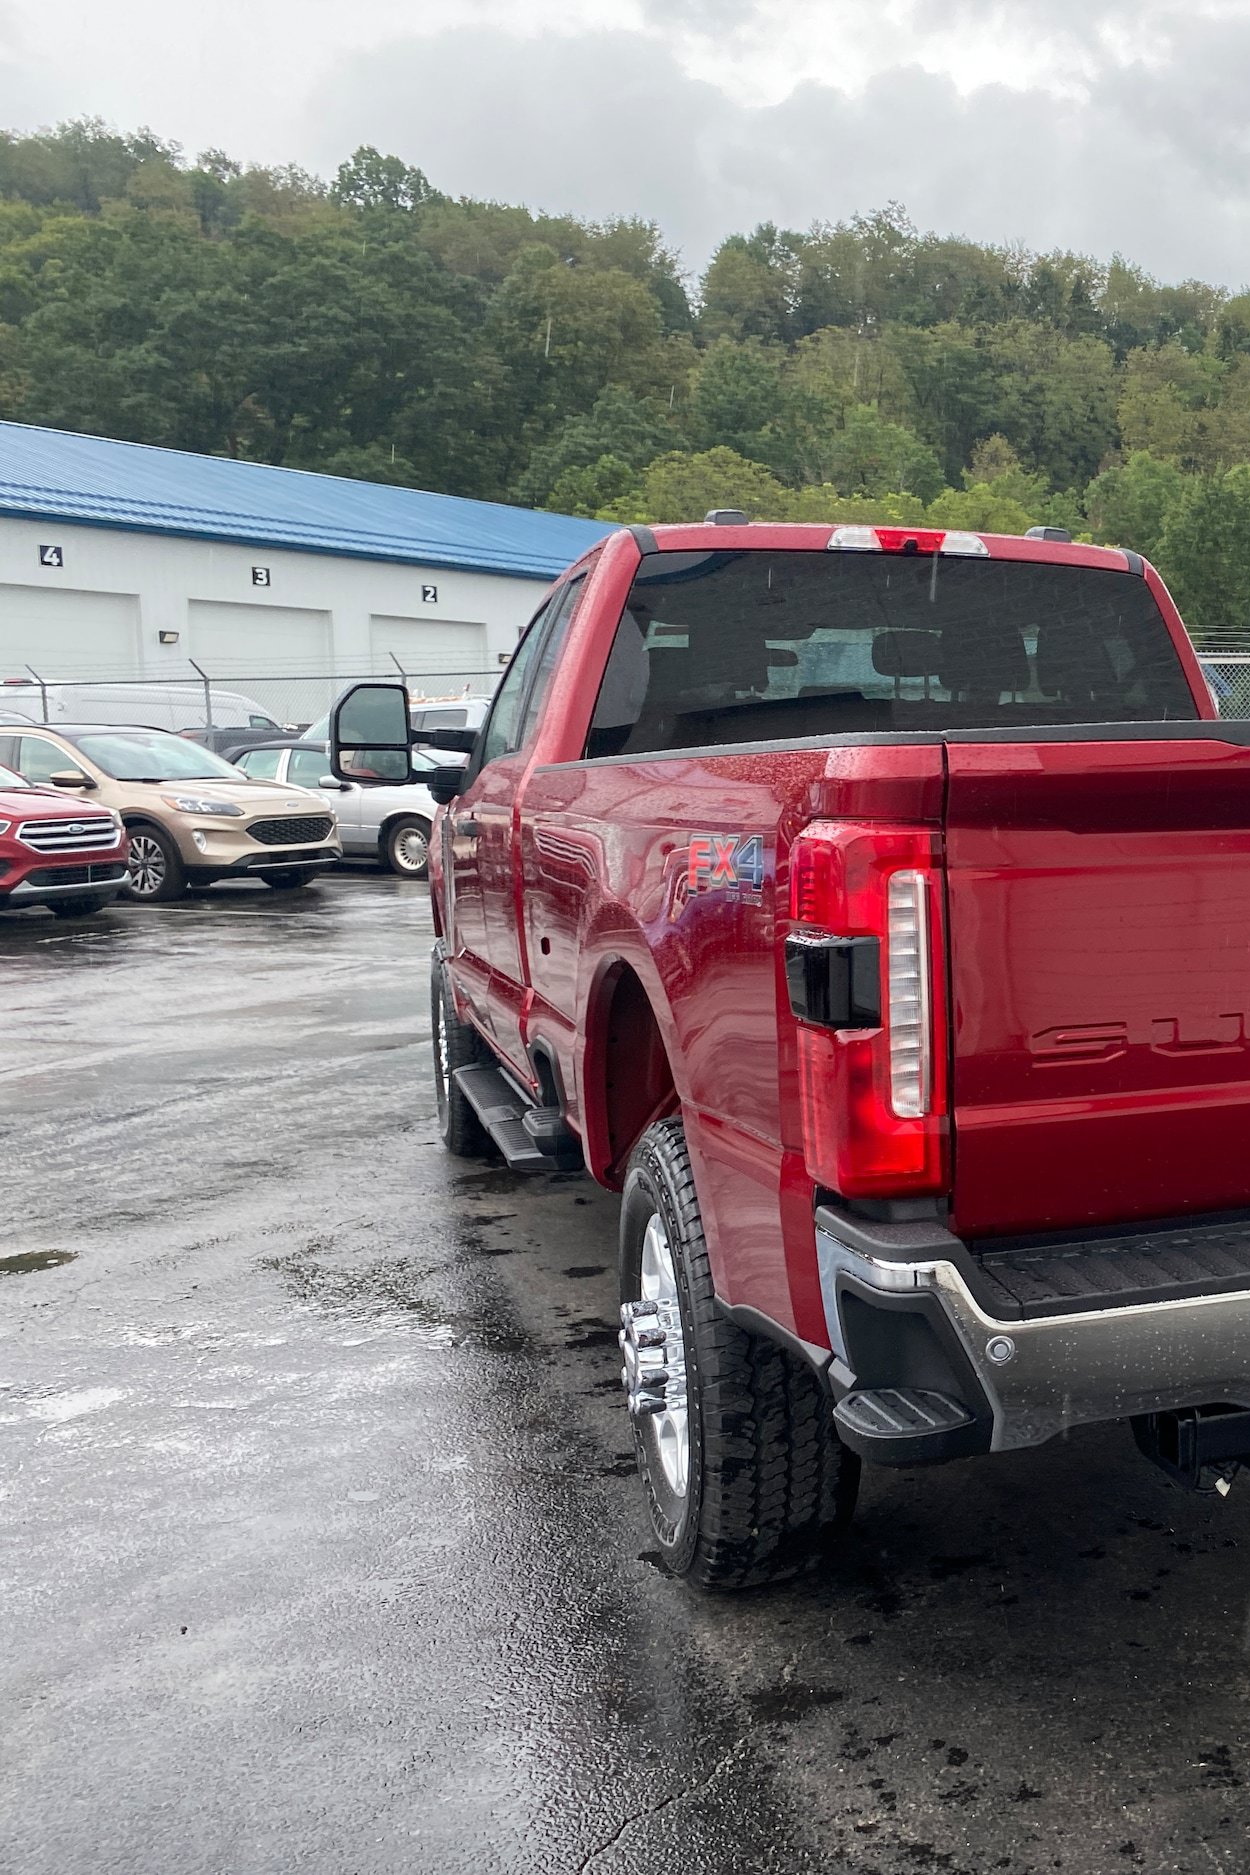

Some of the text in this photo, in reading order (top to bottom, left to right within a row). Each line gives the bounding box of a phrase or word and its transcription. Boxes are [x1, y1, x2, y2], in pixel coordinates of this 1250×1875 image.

[43, 547, 60, 566] 4
[255, 568, 268, 585] 3
[425, 586, 436, 602] 2
[687, 834, 763, 897] FX4
